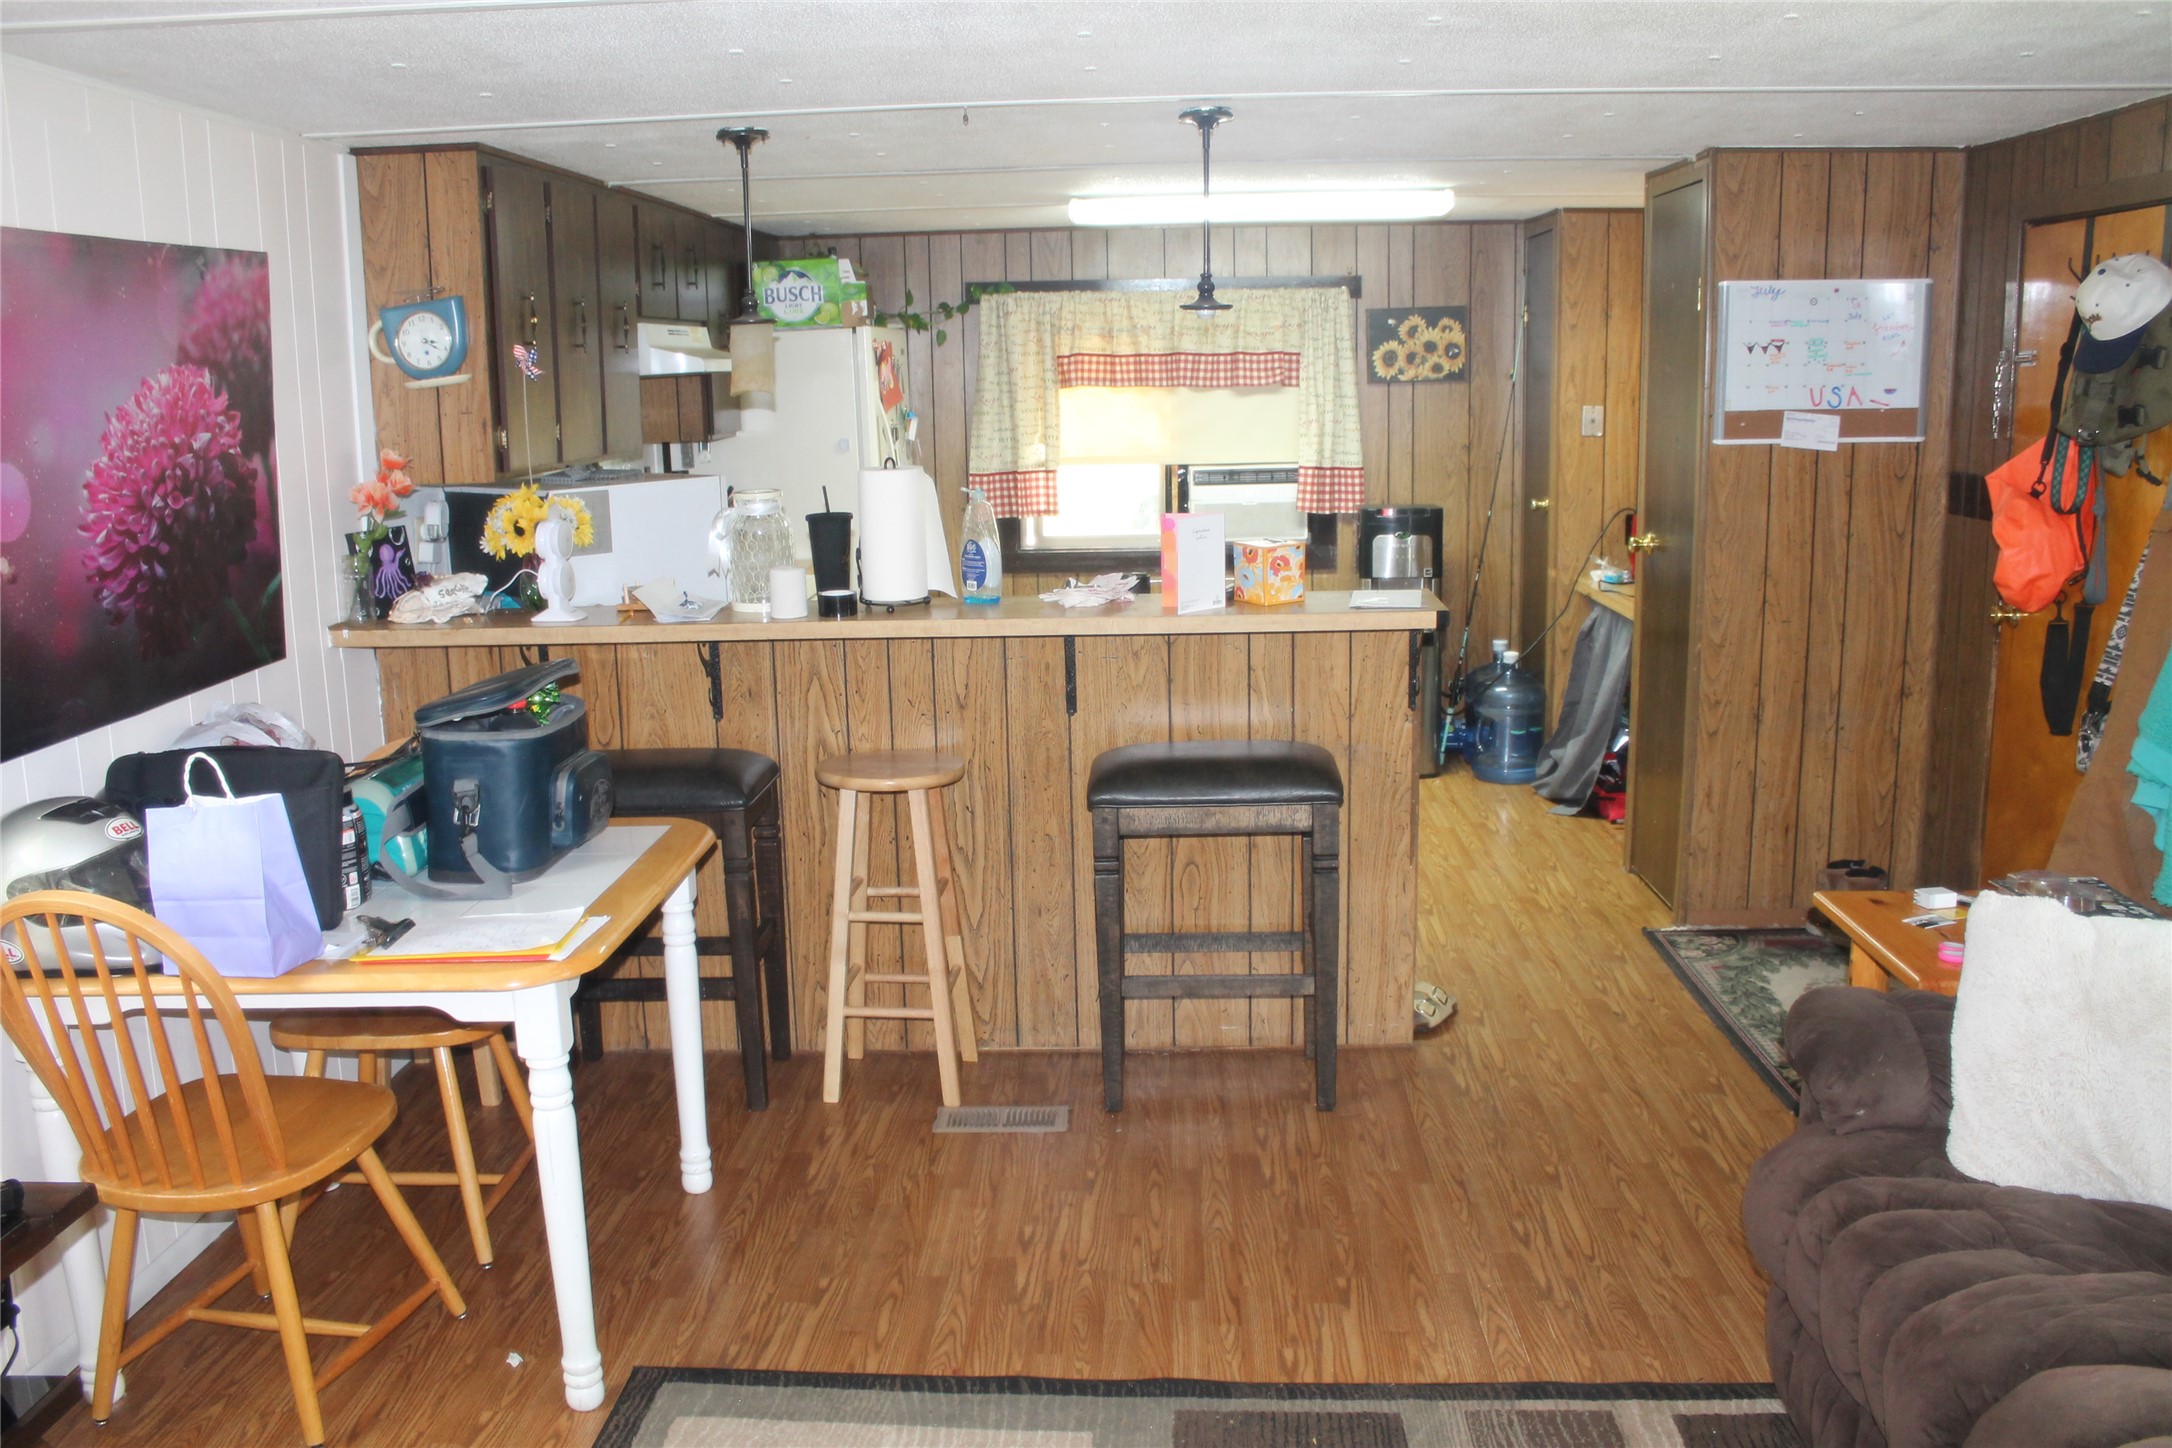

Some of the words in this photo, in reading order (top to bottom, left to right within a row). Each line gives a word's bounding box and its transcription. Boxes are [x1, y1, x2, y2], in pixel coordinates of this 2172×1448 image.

[764, 285, 823, 305] BUSCH
[1750, 285, 1787, 301] July
[1809, 386, 1863, 409] USA
[111, 821, 140, 835] BELL
